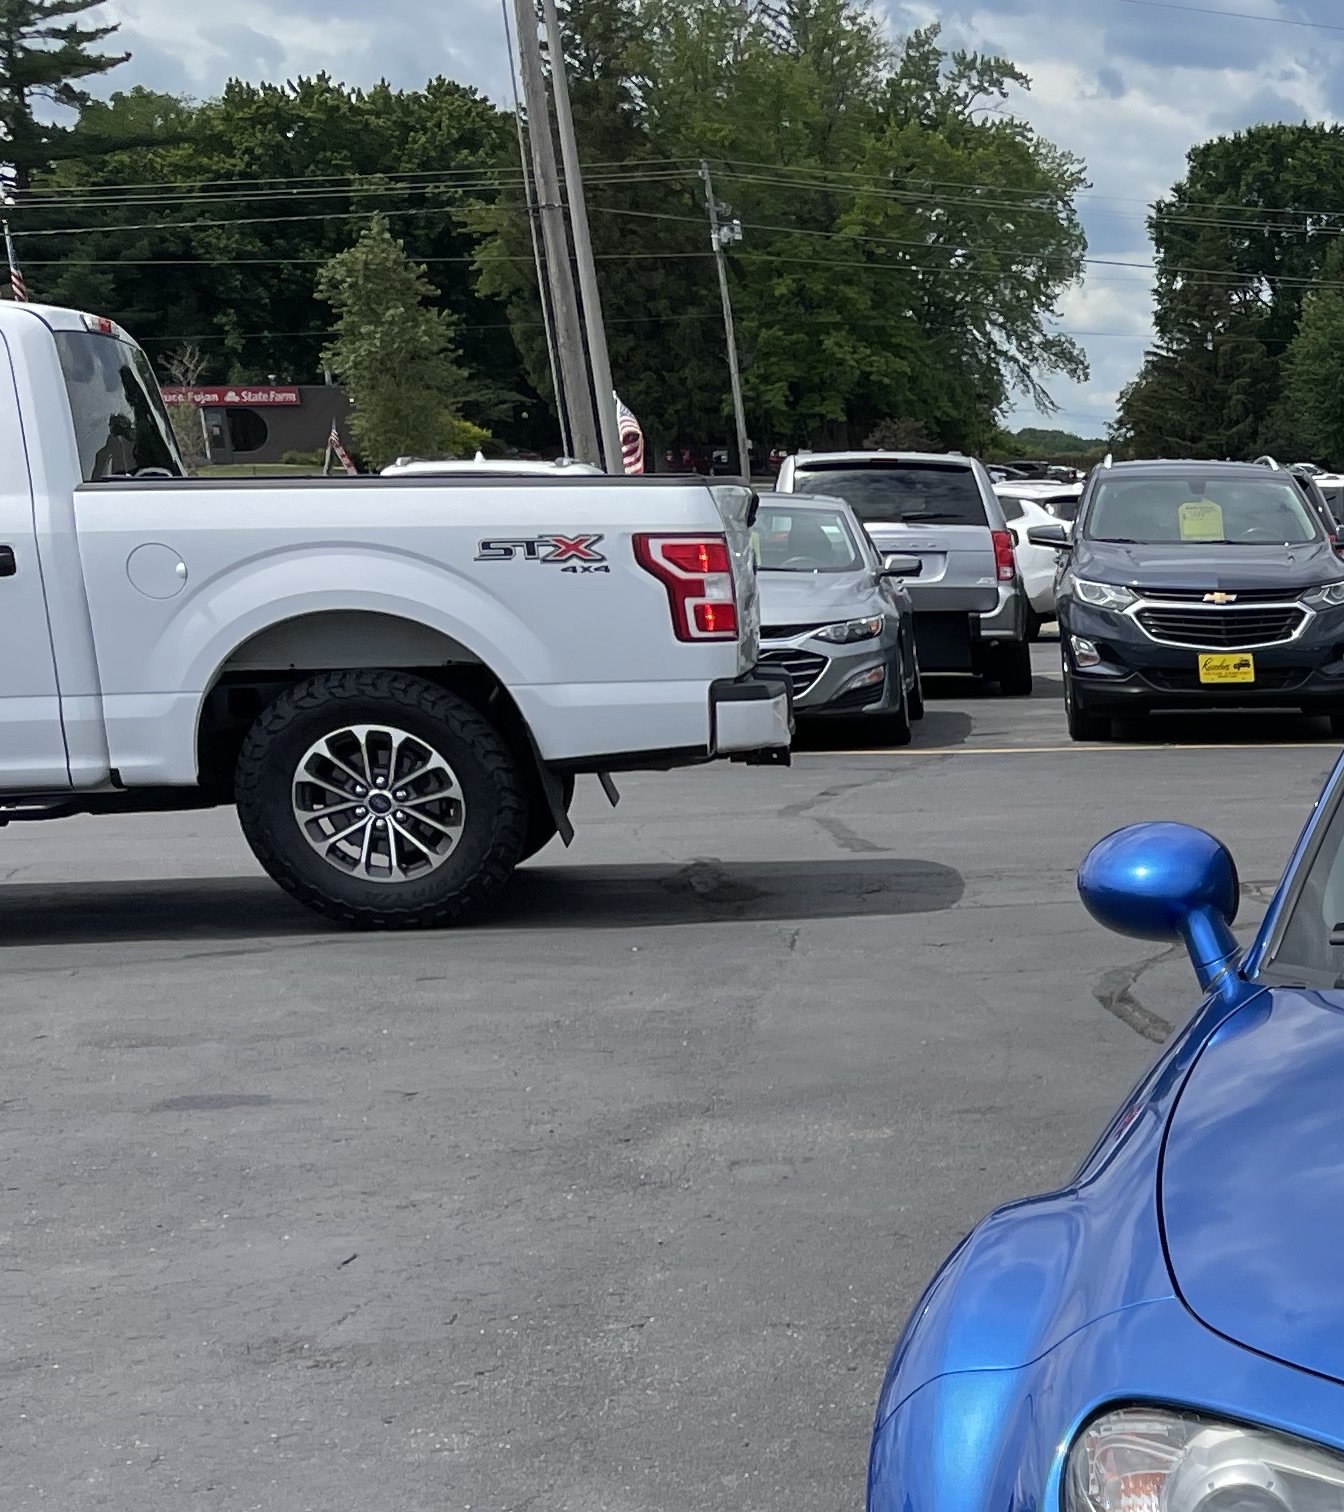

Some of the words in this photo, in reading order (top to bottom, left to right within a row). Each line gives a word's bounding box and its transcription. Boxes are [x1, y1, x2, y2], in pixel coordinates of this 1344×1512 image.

[241, 390, 268, 402] State
[269, 390, 296, 402] Farm
[473, 533, 608, 564] STX
